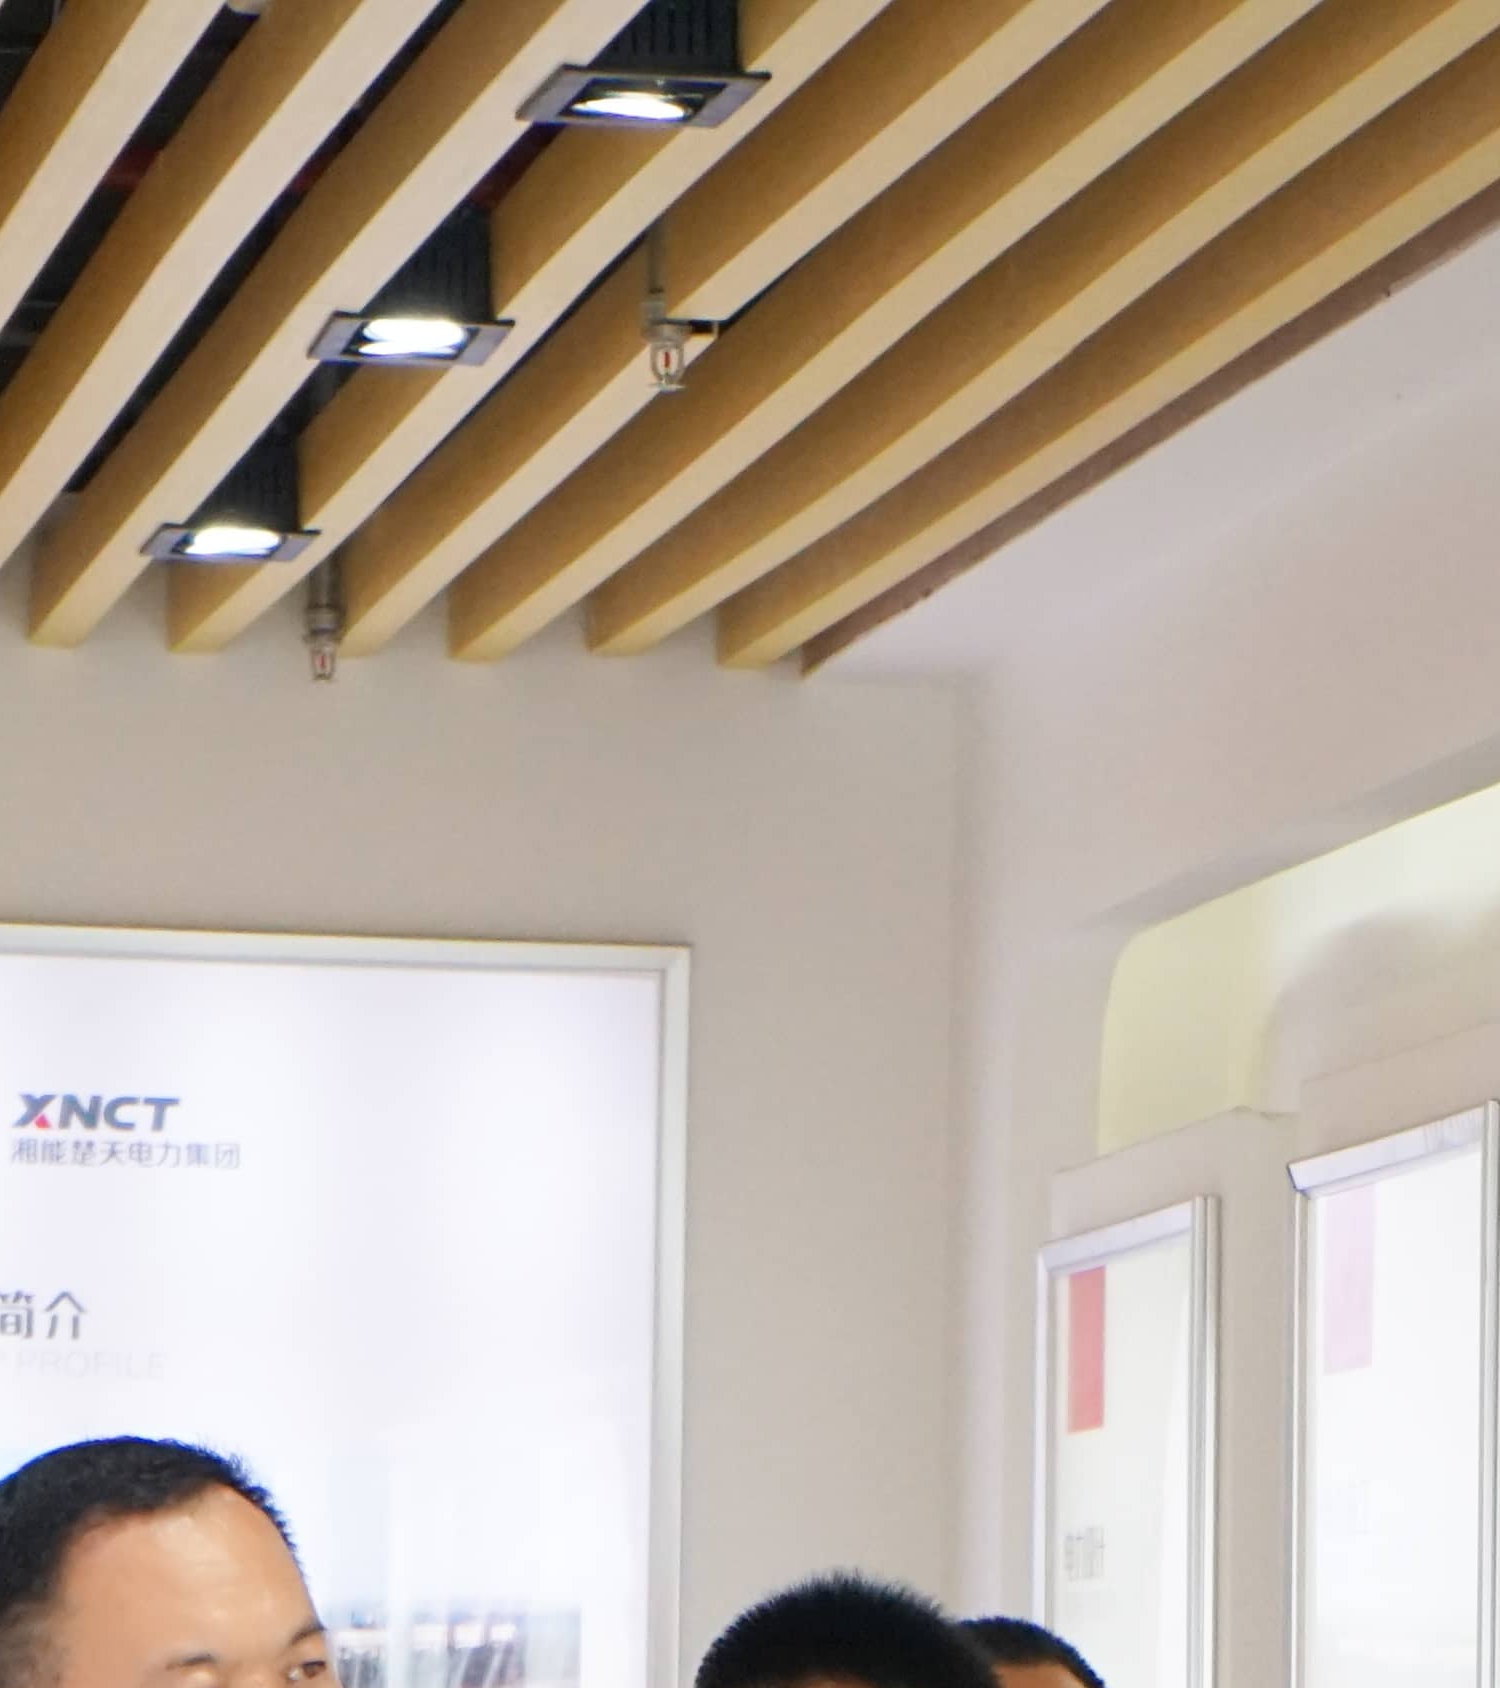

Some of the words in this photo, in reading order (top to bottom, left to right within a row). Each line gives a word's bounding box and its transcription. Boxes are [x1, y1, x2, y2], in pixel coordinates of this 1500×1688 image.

[11, 1092, 182, 1133] XNCT
[10, 1137, 242, 1170] 湘能楚天电力集团
